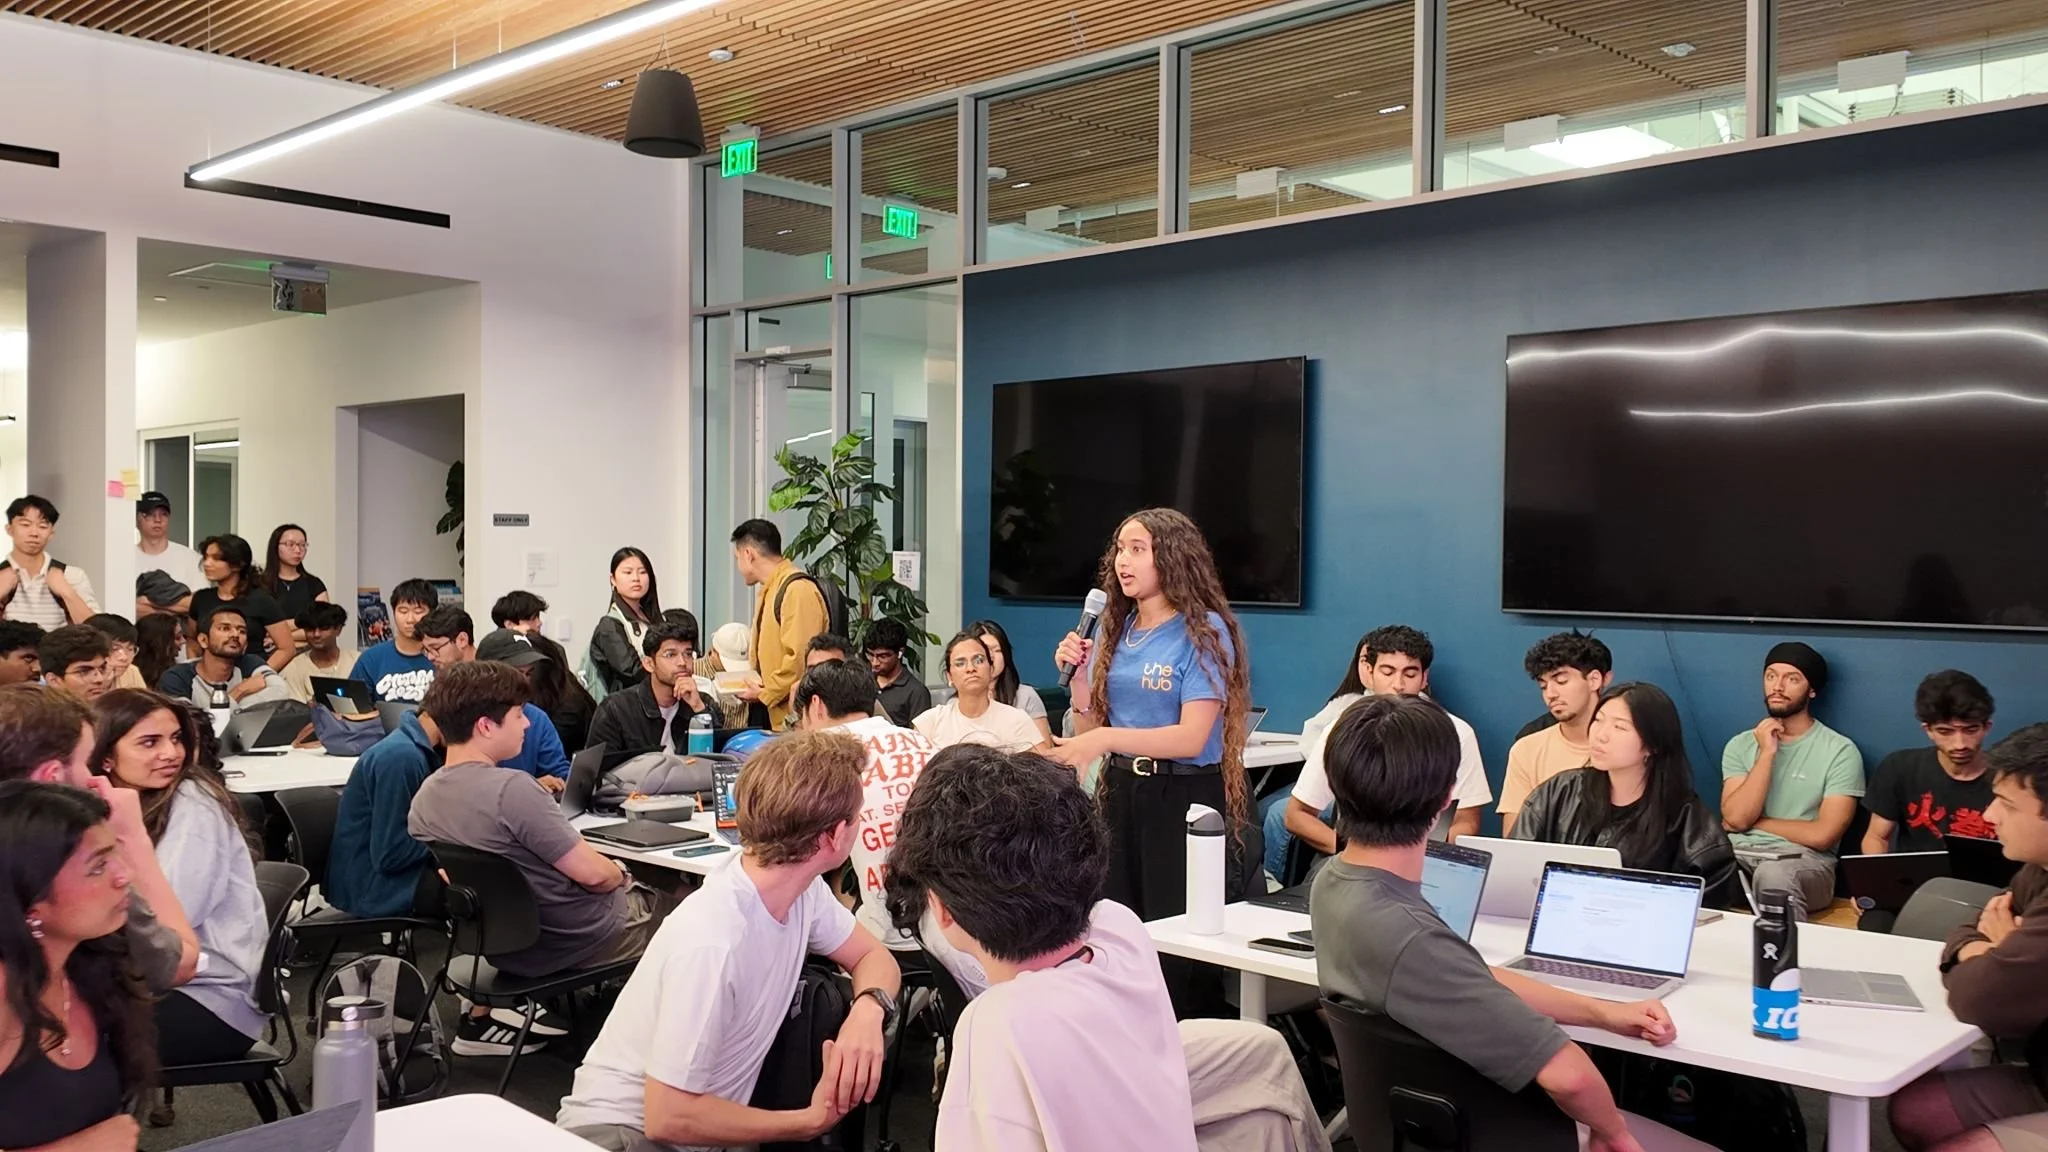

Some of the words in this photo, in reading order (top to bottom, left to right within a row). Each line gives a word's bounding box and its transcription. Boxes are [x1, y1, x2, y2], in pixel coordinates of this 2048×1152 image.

[728, 142, 754, 176] EXIT
[888, 207, 914, 237] EXIT
[1143, 661, 1173, 677] the
[1142, 676, 1172, 691] hub
[883, 801, 904, 817] SE
[862, 822, 898, 852] GE
